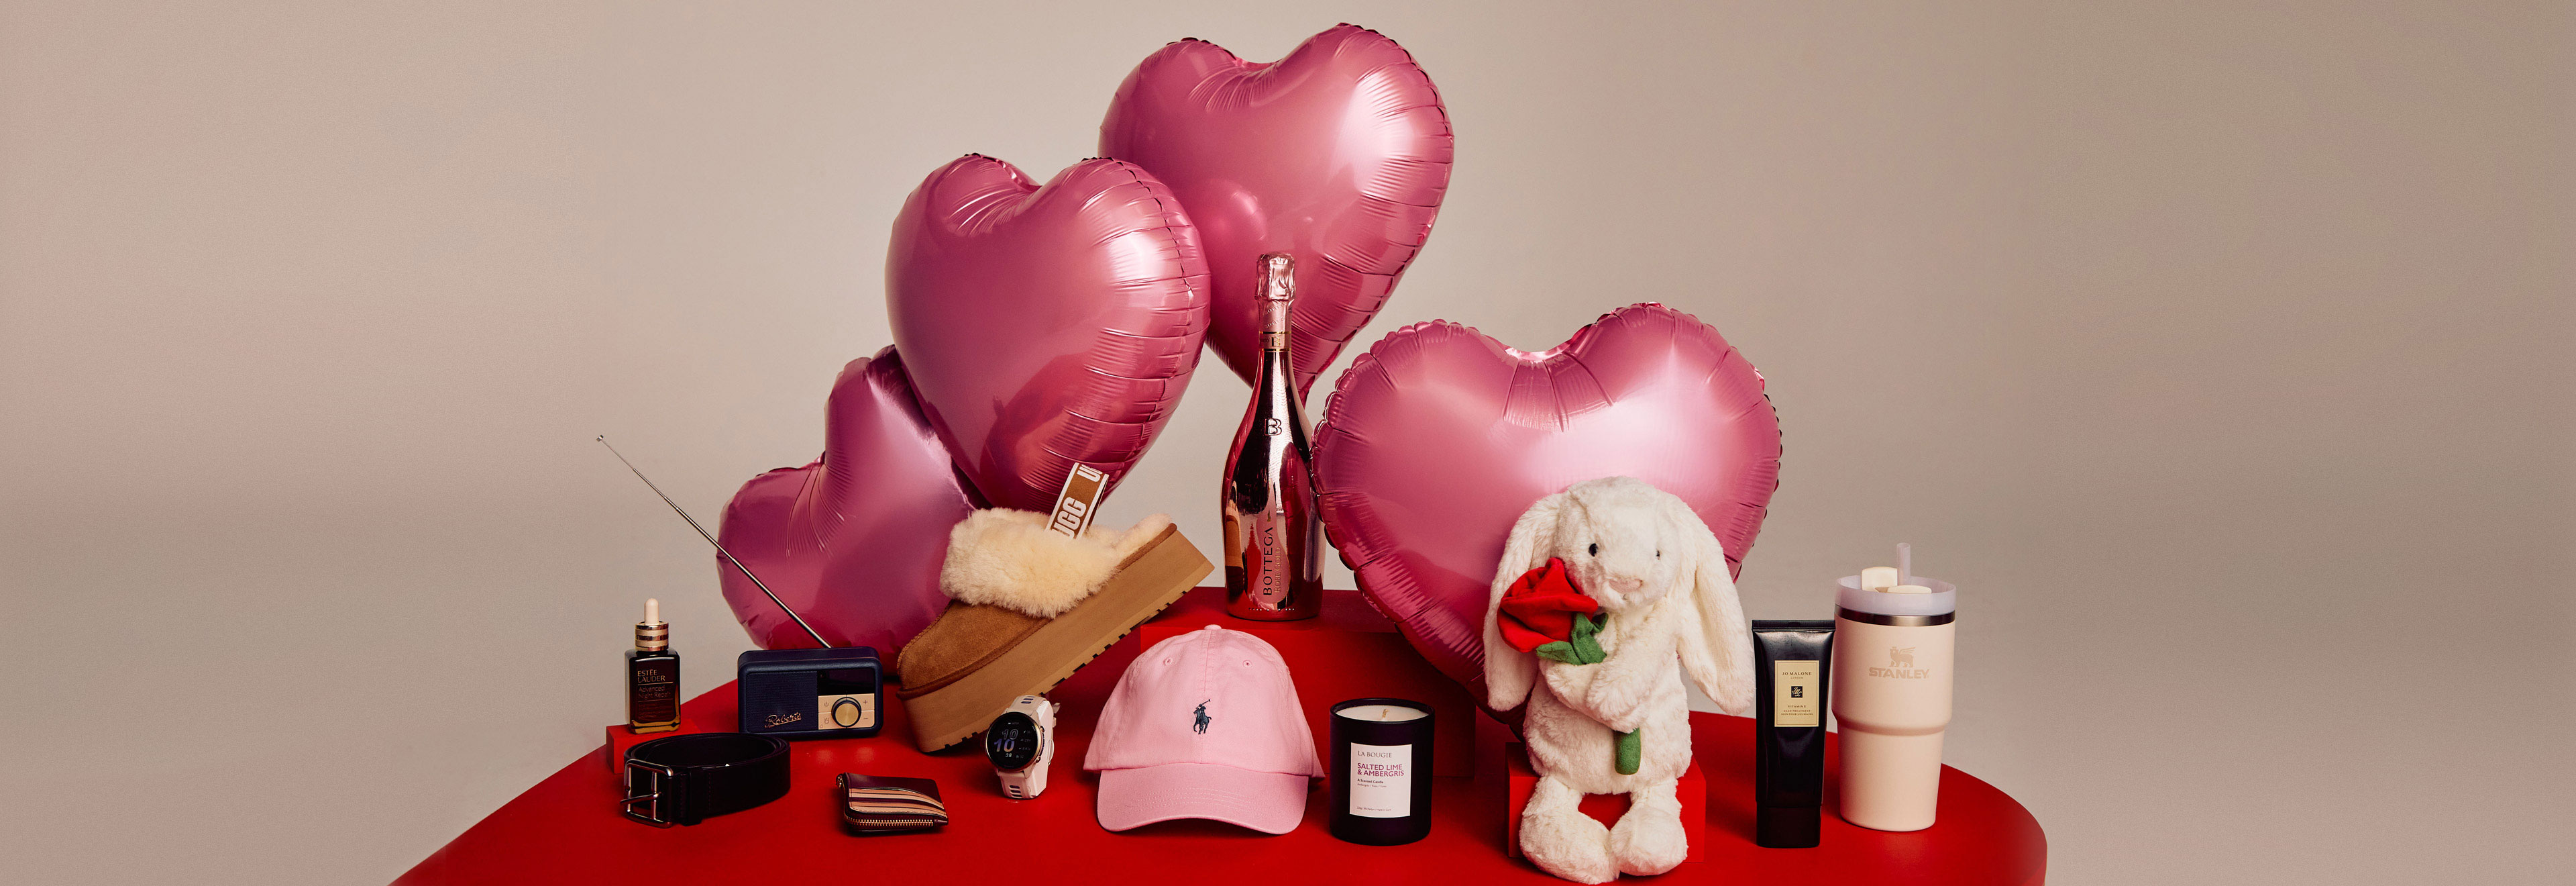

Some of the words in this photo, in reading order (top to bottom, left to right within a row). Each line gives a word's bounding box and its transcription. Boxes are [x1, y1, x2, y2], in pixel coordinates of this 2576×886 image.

[1263, 526, 1273, 596] BOTTEGA
[1274, 546, 1282, 571] GOLD
[1868, 667, 1930, 679] STANLEY
[1002, 729, 1018, 740] 10
[994, 738, 1015, 752] 10
[1357, 762, 1385, 771] SALTED
